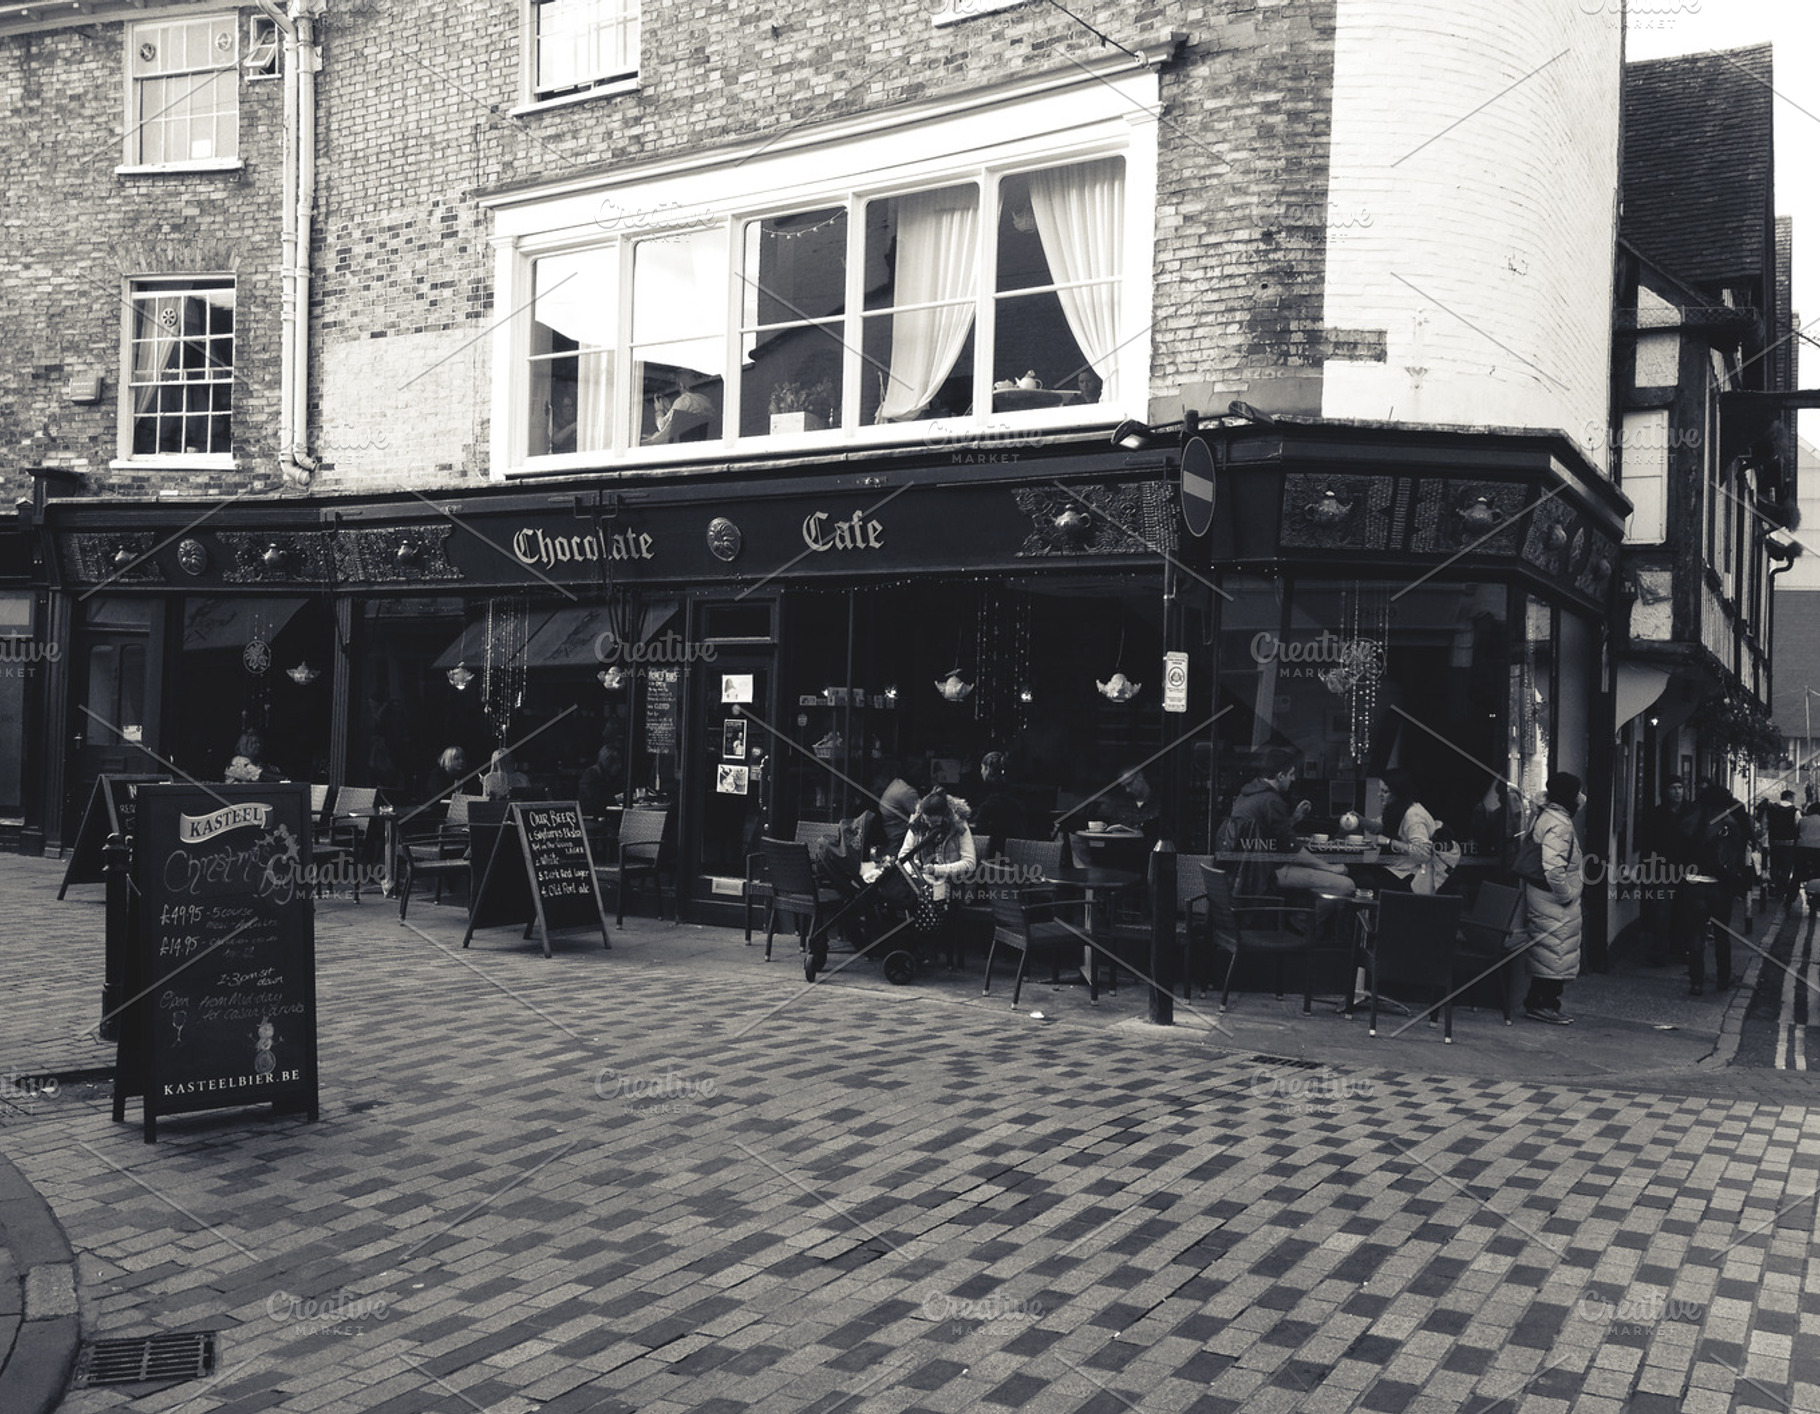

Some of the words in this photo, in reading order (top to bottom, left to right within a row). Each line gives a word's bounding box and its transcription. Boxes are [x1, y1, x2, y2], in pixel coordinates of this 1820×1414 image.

[802, 509, 885, 552] Cafe
[190, 807, 262, 837] KASTEEL
[1240, 838, 1277, 850] WINE
[160, 904, 204, 926] £49.95
[160, 936, 199, 957] £14.95
[163, 1069, 300, 1095] KASTEELBIER.BE
